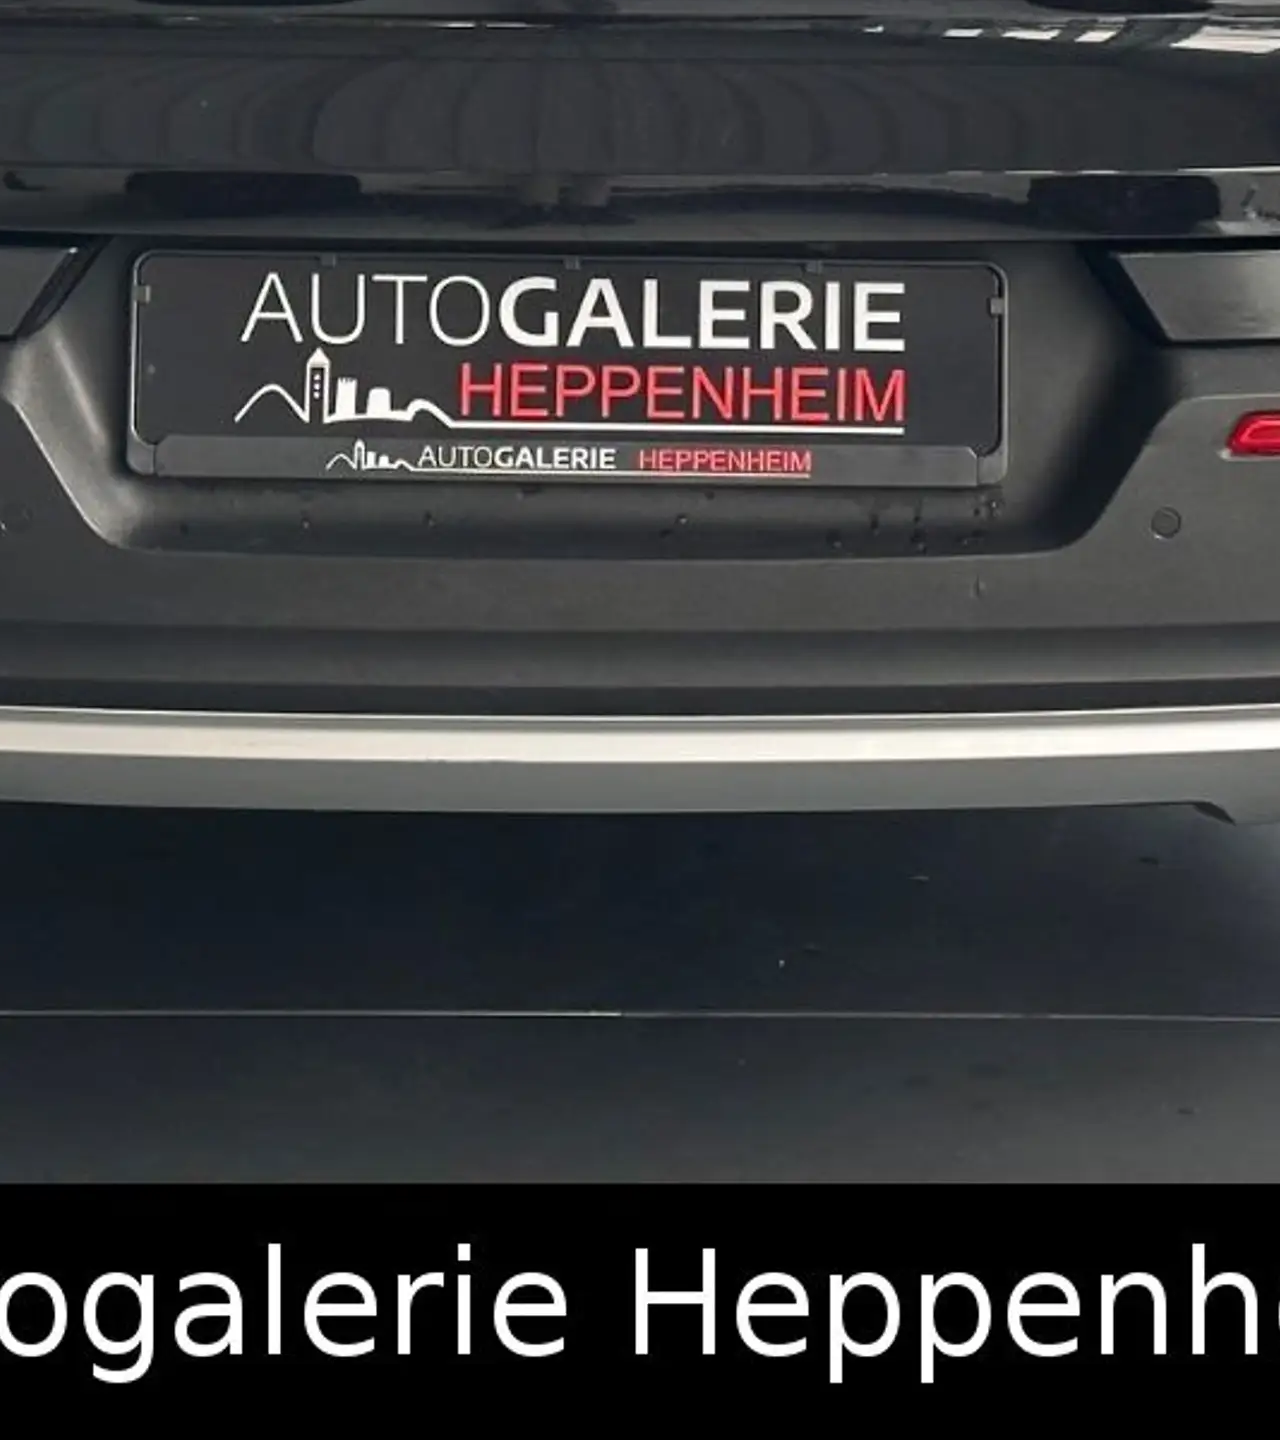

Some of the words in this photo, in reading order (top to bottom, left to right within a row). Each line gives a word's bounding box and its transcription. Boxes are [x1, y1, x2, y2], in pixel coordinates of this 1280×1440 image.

[240, 272, 906, 352] AUTOGALERIE
[458, 360, 907, 423] HEPPENHEIM
[418, 444, 617, 469] AUTOGALERIE
[637, 448, 813, 473] HEPPENHEIM
